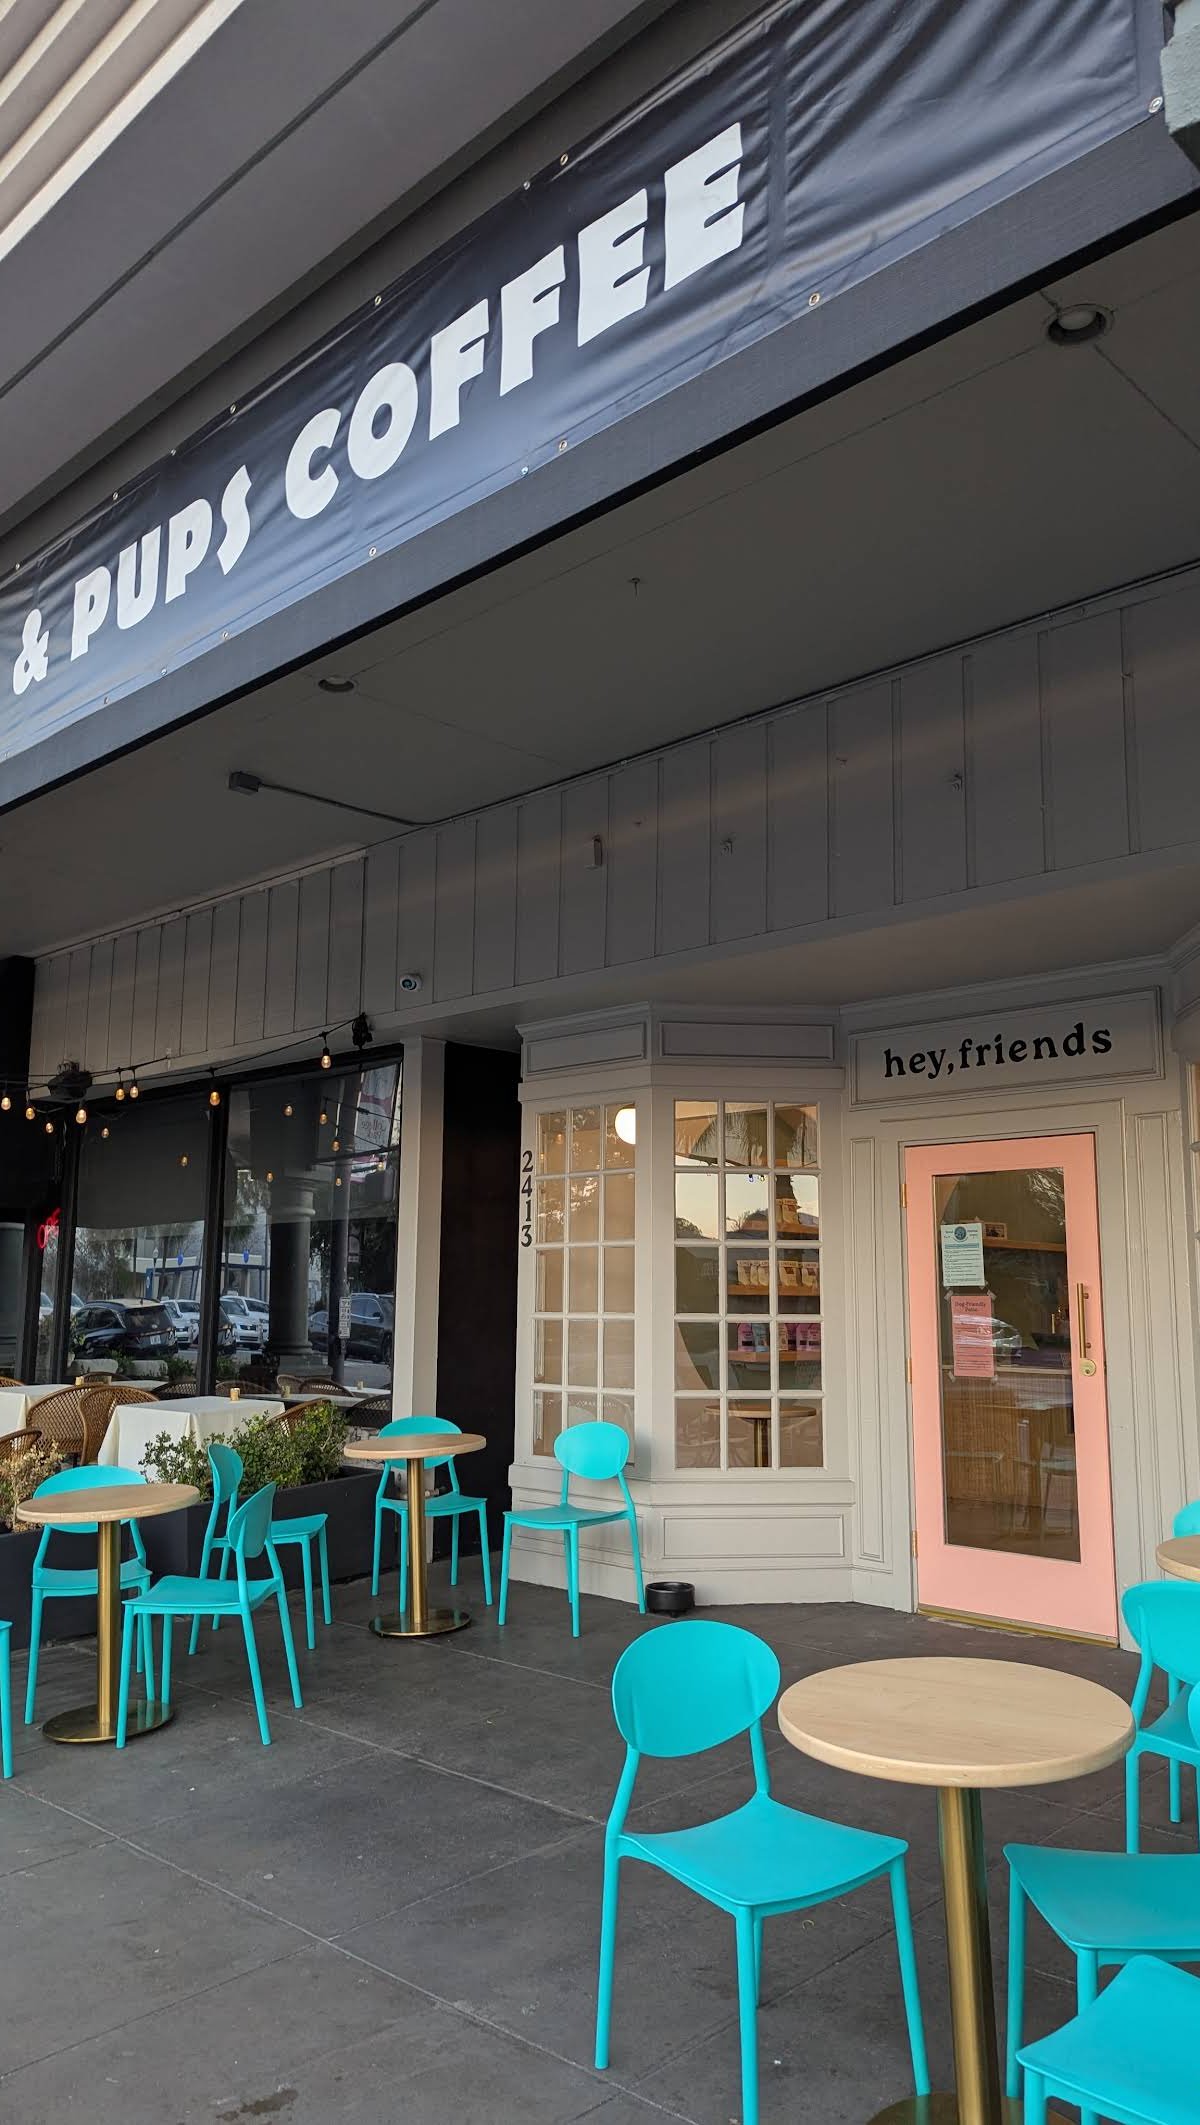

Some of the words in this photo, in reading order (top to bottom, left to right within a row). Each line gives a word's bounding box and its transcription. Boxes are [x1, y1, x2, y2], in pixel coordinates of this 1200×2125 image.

[13, 608, 48, 695] &
[70, 464, 252, 660] PUPS
[285, 122, 746, 520] COFFEE
[520, 1150, 534, 1247] 2413
